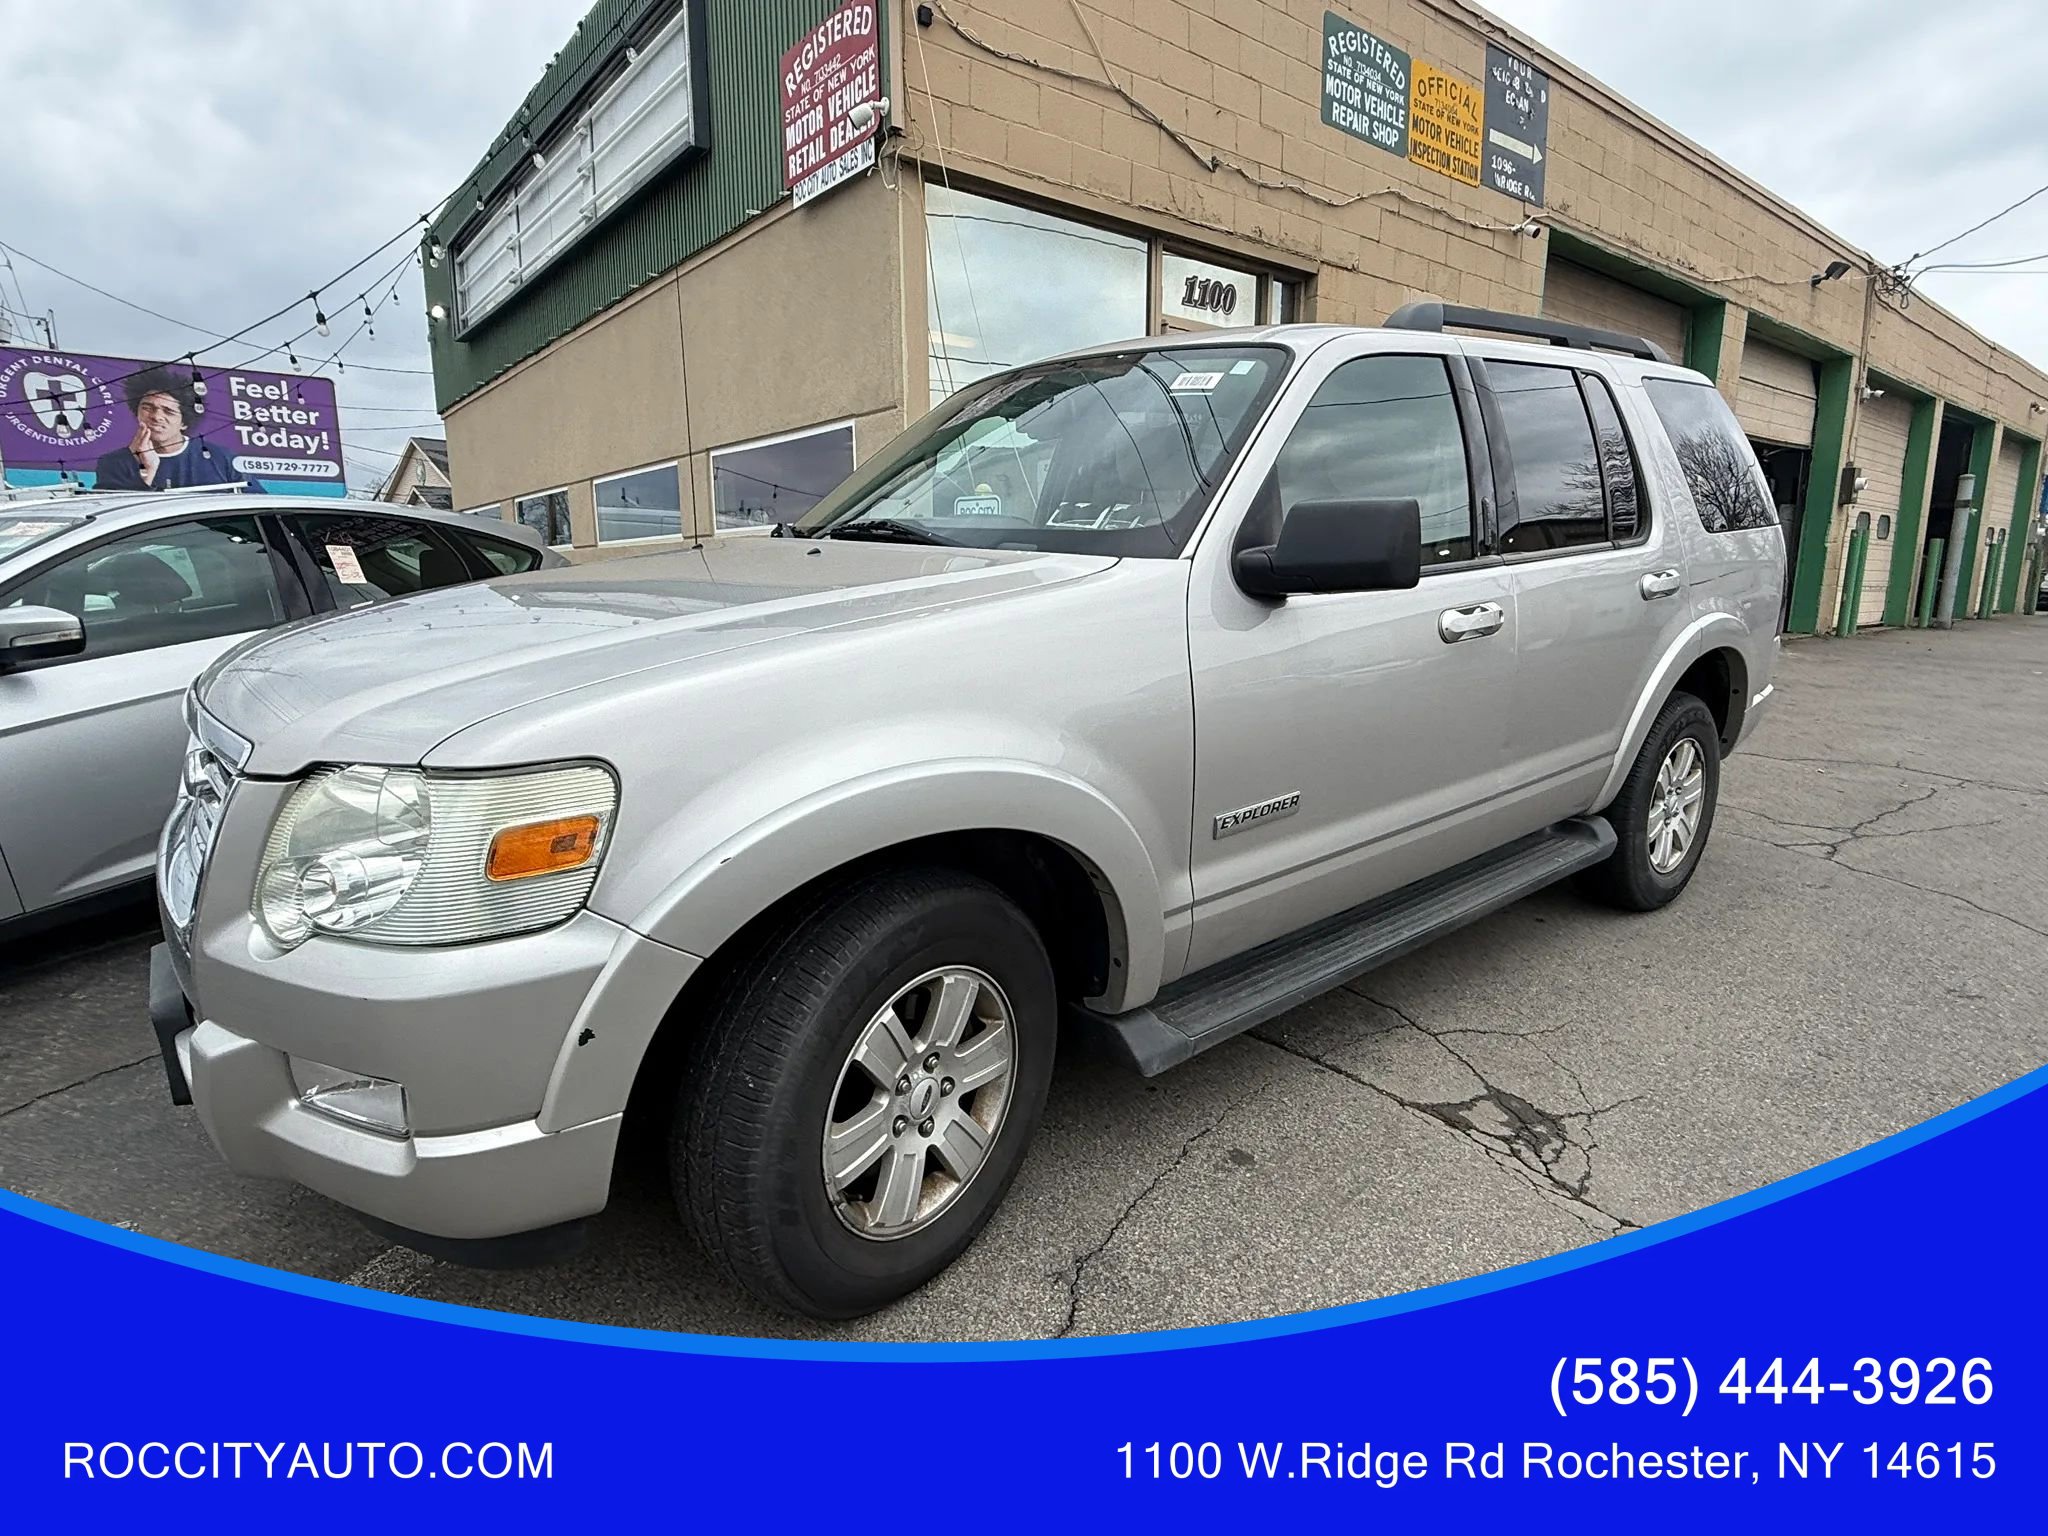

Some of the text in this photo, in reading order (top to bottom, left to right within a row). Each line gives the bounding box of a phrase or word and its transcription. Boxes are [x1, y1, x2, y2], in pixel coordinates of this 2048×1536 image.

[785, 5, 872, 98] REGISTERED
[1328, 30, 1406, 90] REGISTERED
[785, 43, 875, 123] STATE OF NEW YORK
[1325, 73, 1405, 130] MOTOR VEHICLE
[1327, 58, 1405, 106] STATE OF NEW YORK
[1417, 77, 1478, 122] OFFICIAL
[786, 63, 876, 151] MOTOR VEHICLE
[1332, 101, 1399, 148] REPAIR SHOP
[1413, 98, 1434, 116] STATE
[1435, 108, 1445, 120] OF
[1462, 120, 1479, 136] YORK
[789, 110, 875, 180] RETAIL DEA
[1409, 136, 1479, 182] INSPECTION STATION
[1412, 113, 1479, 159] MOTOR VEHICLE
[1181, 275, 1237, 315] 1100
[0, 356, 114, 405] URGENT DENTAL CARE
[229, 376, 289, 401] Feel
[233, 400, 320, 426] Better
[234, 425, 330, 455] Today!
[242, 460, 330, 473] (585) 729-7777
[1220, 794, 1300, 830] EXPLORER
